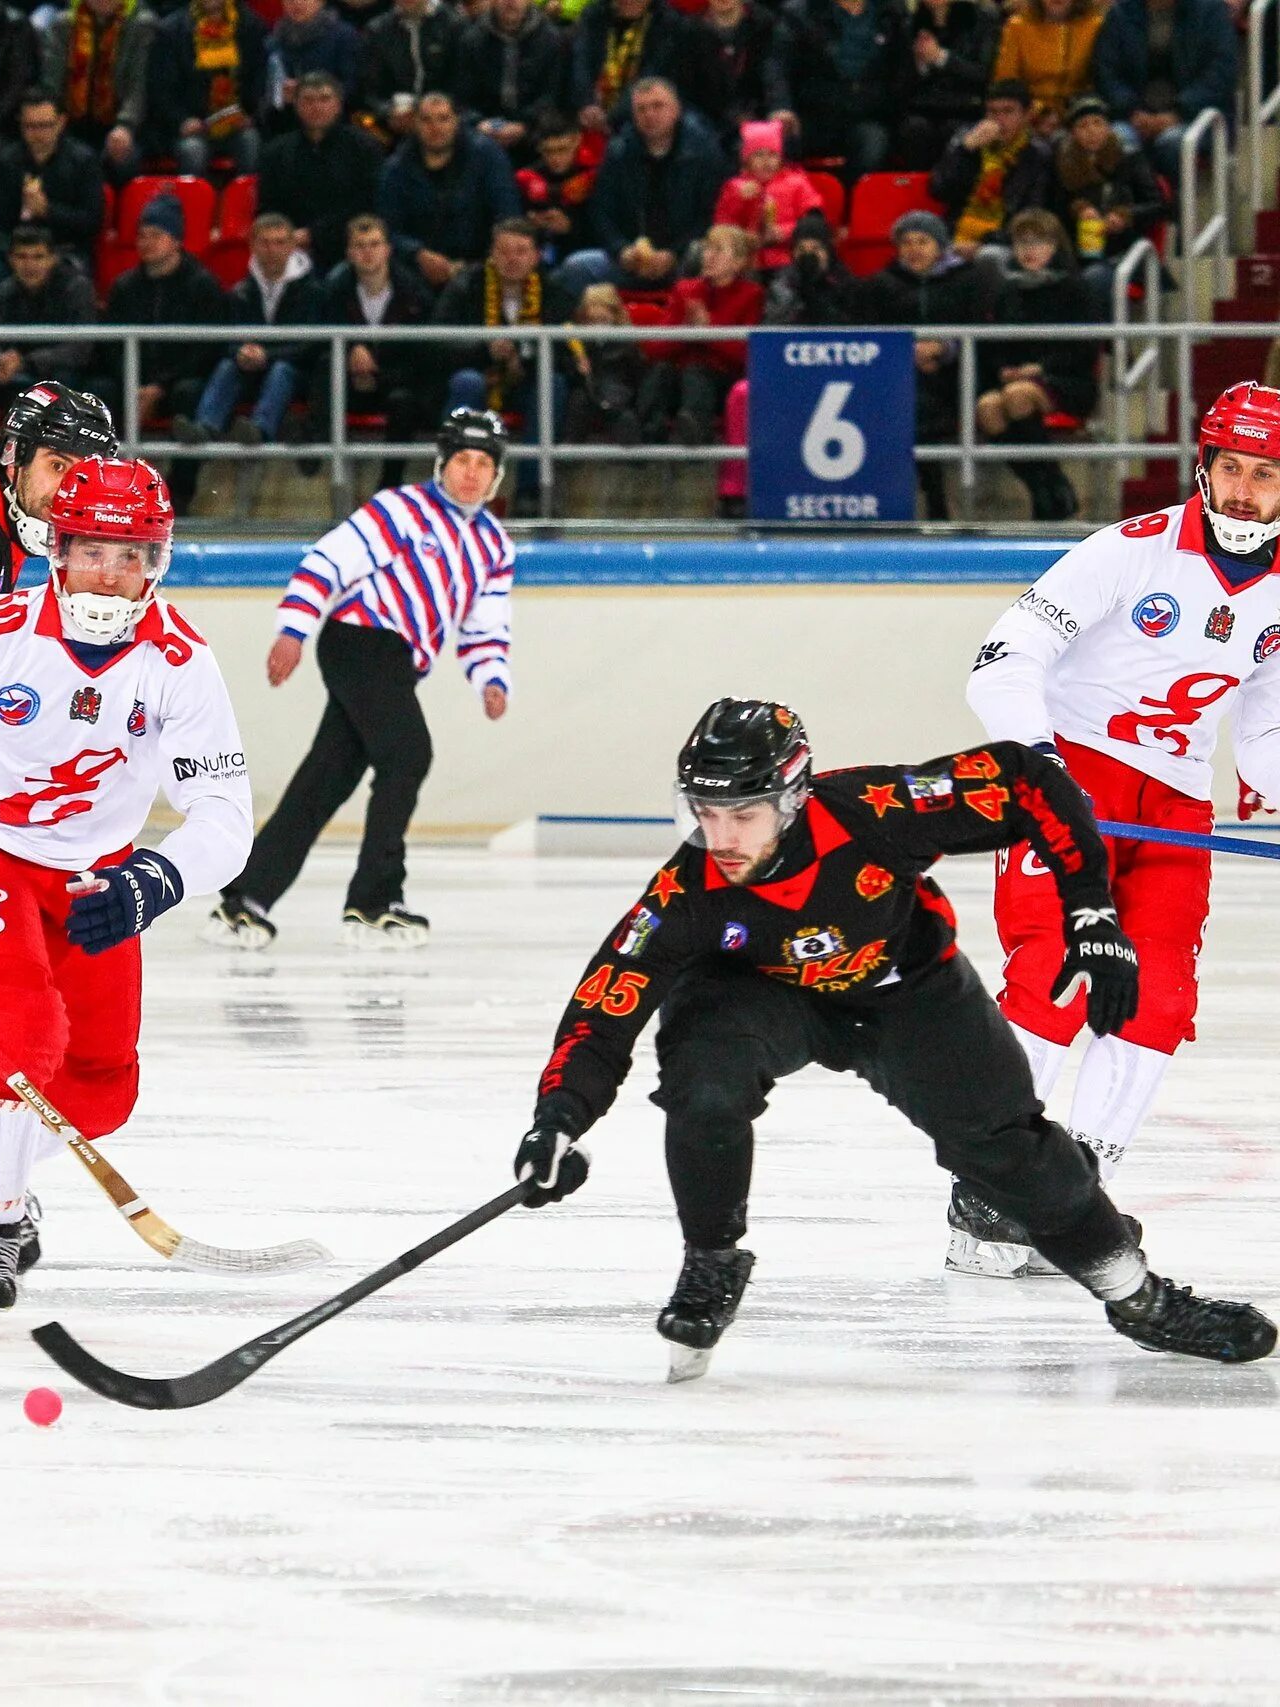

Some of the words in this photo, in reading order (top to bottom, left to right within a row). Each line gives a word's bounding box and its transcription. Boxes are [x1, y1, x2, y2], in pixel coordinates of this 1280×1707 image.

[784, 342, 881, 366] СЕКТОР
[78, 426, 110, 444] CCM
[802, 380, 866, 483] 6
[1232, 424, 1269, 441] Reebok
[785, 494, 880, 518] SECTOR
[93, 511, 133, 526] Reebok
[692, 776, 732, 788] CCM
[952, 750, 1011, 823] 45
[120, 869, 145, 934] Reebok
[1079, 941, 1138, 967] Reebok
[573, 963, 651, 1017] 45
